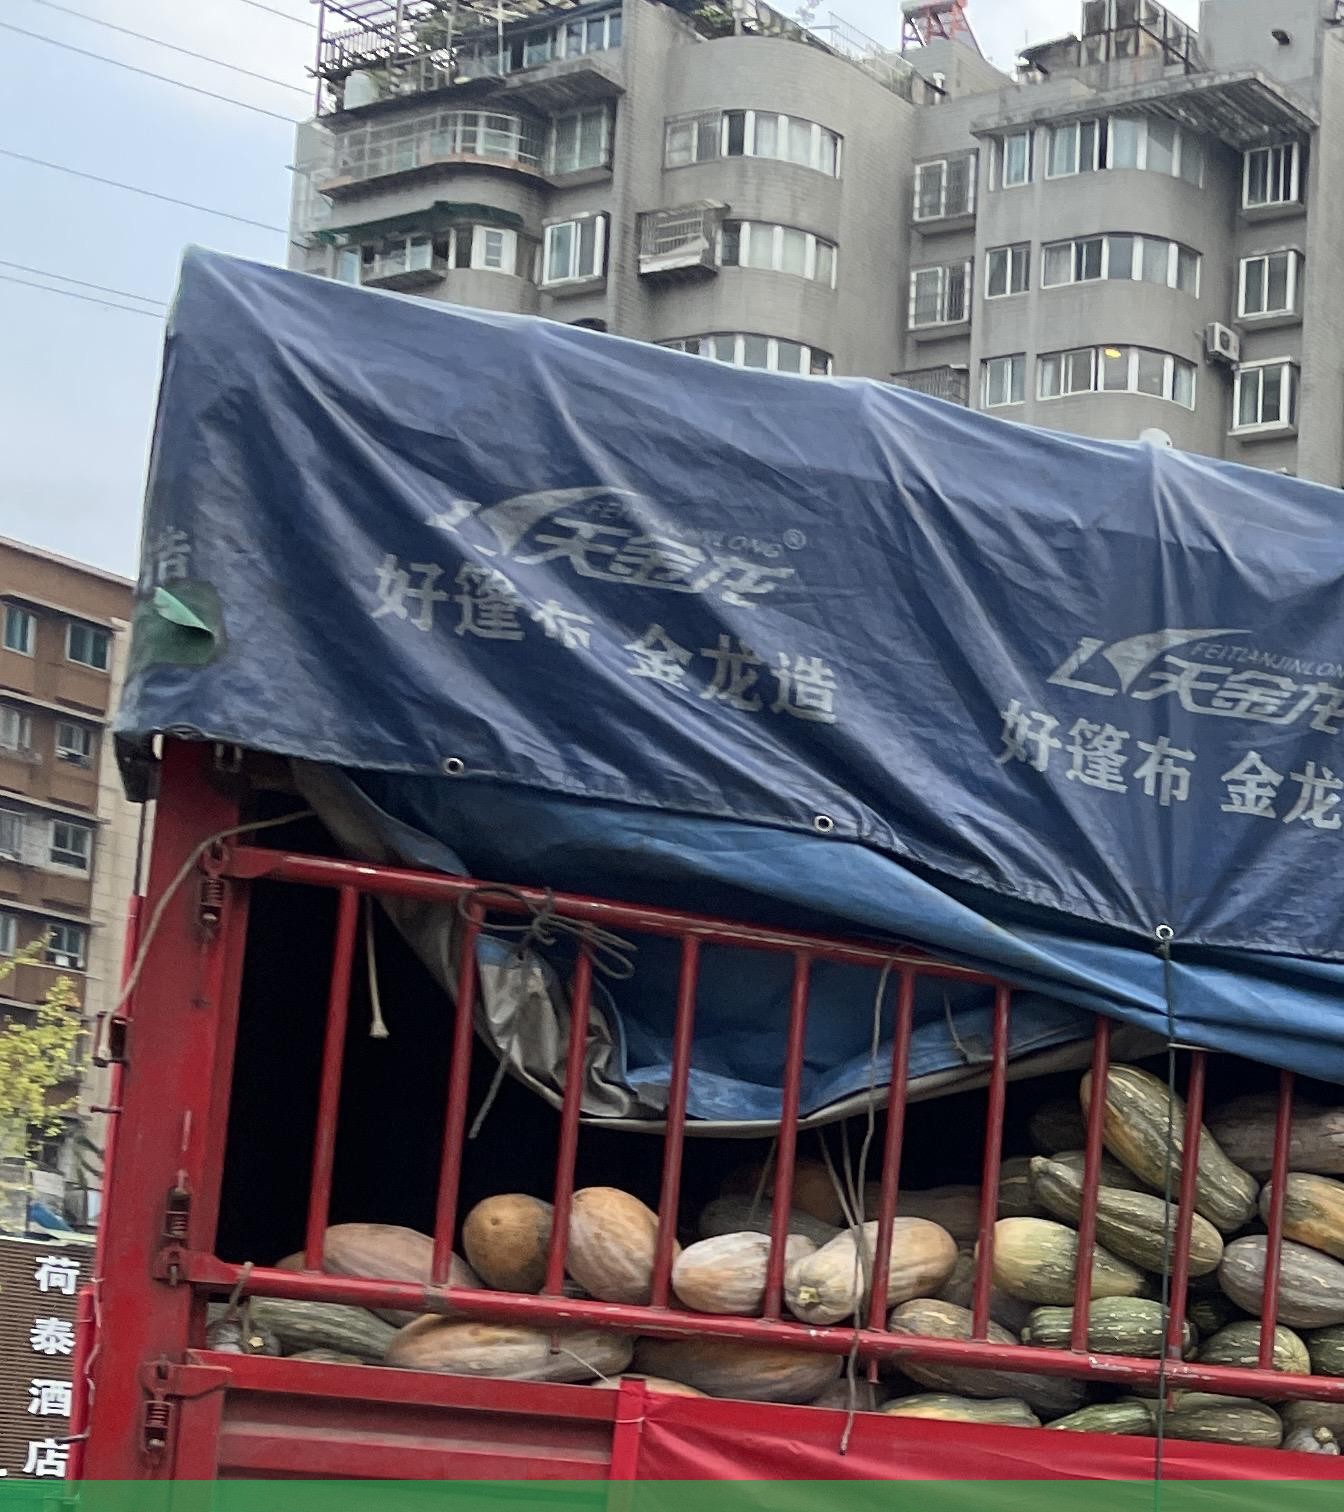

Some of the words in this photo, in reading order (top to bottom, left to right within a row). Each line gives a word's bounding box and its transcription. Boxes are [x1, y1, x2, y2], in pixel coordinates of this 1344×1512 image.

[624, 622, 839, 724] 金龙造
[997, 698, 1197, 807] 好篷布
[23, 1255, 81, 1478] 荷泰酒店
